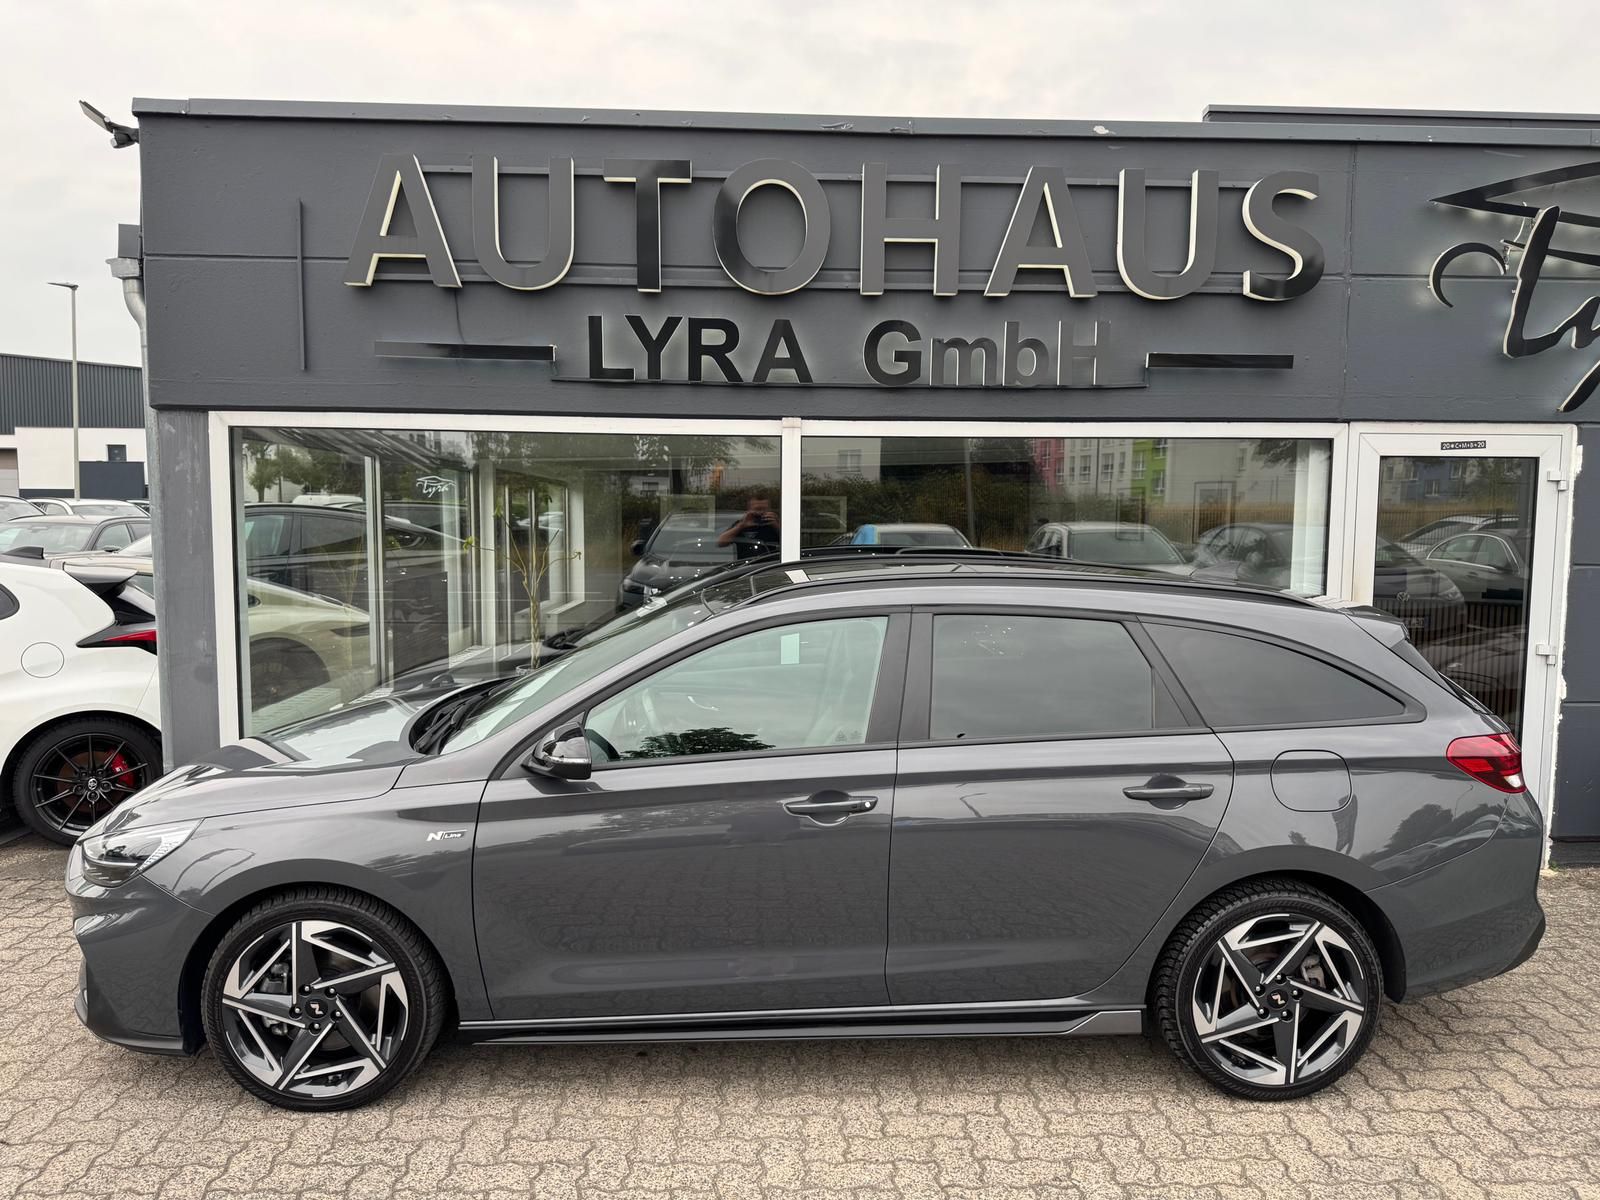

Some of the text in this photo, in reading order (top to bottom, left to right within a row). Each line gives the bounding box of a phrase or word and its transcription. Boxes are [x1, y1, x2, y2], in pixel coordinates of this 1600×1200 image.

[344, 154, 1325, 302] AUTOHAUS
[588, 314, 1112, 388] LYRA GmbH
